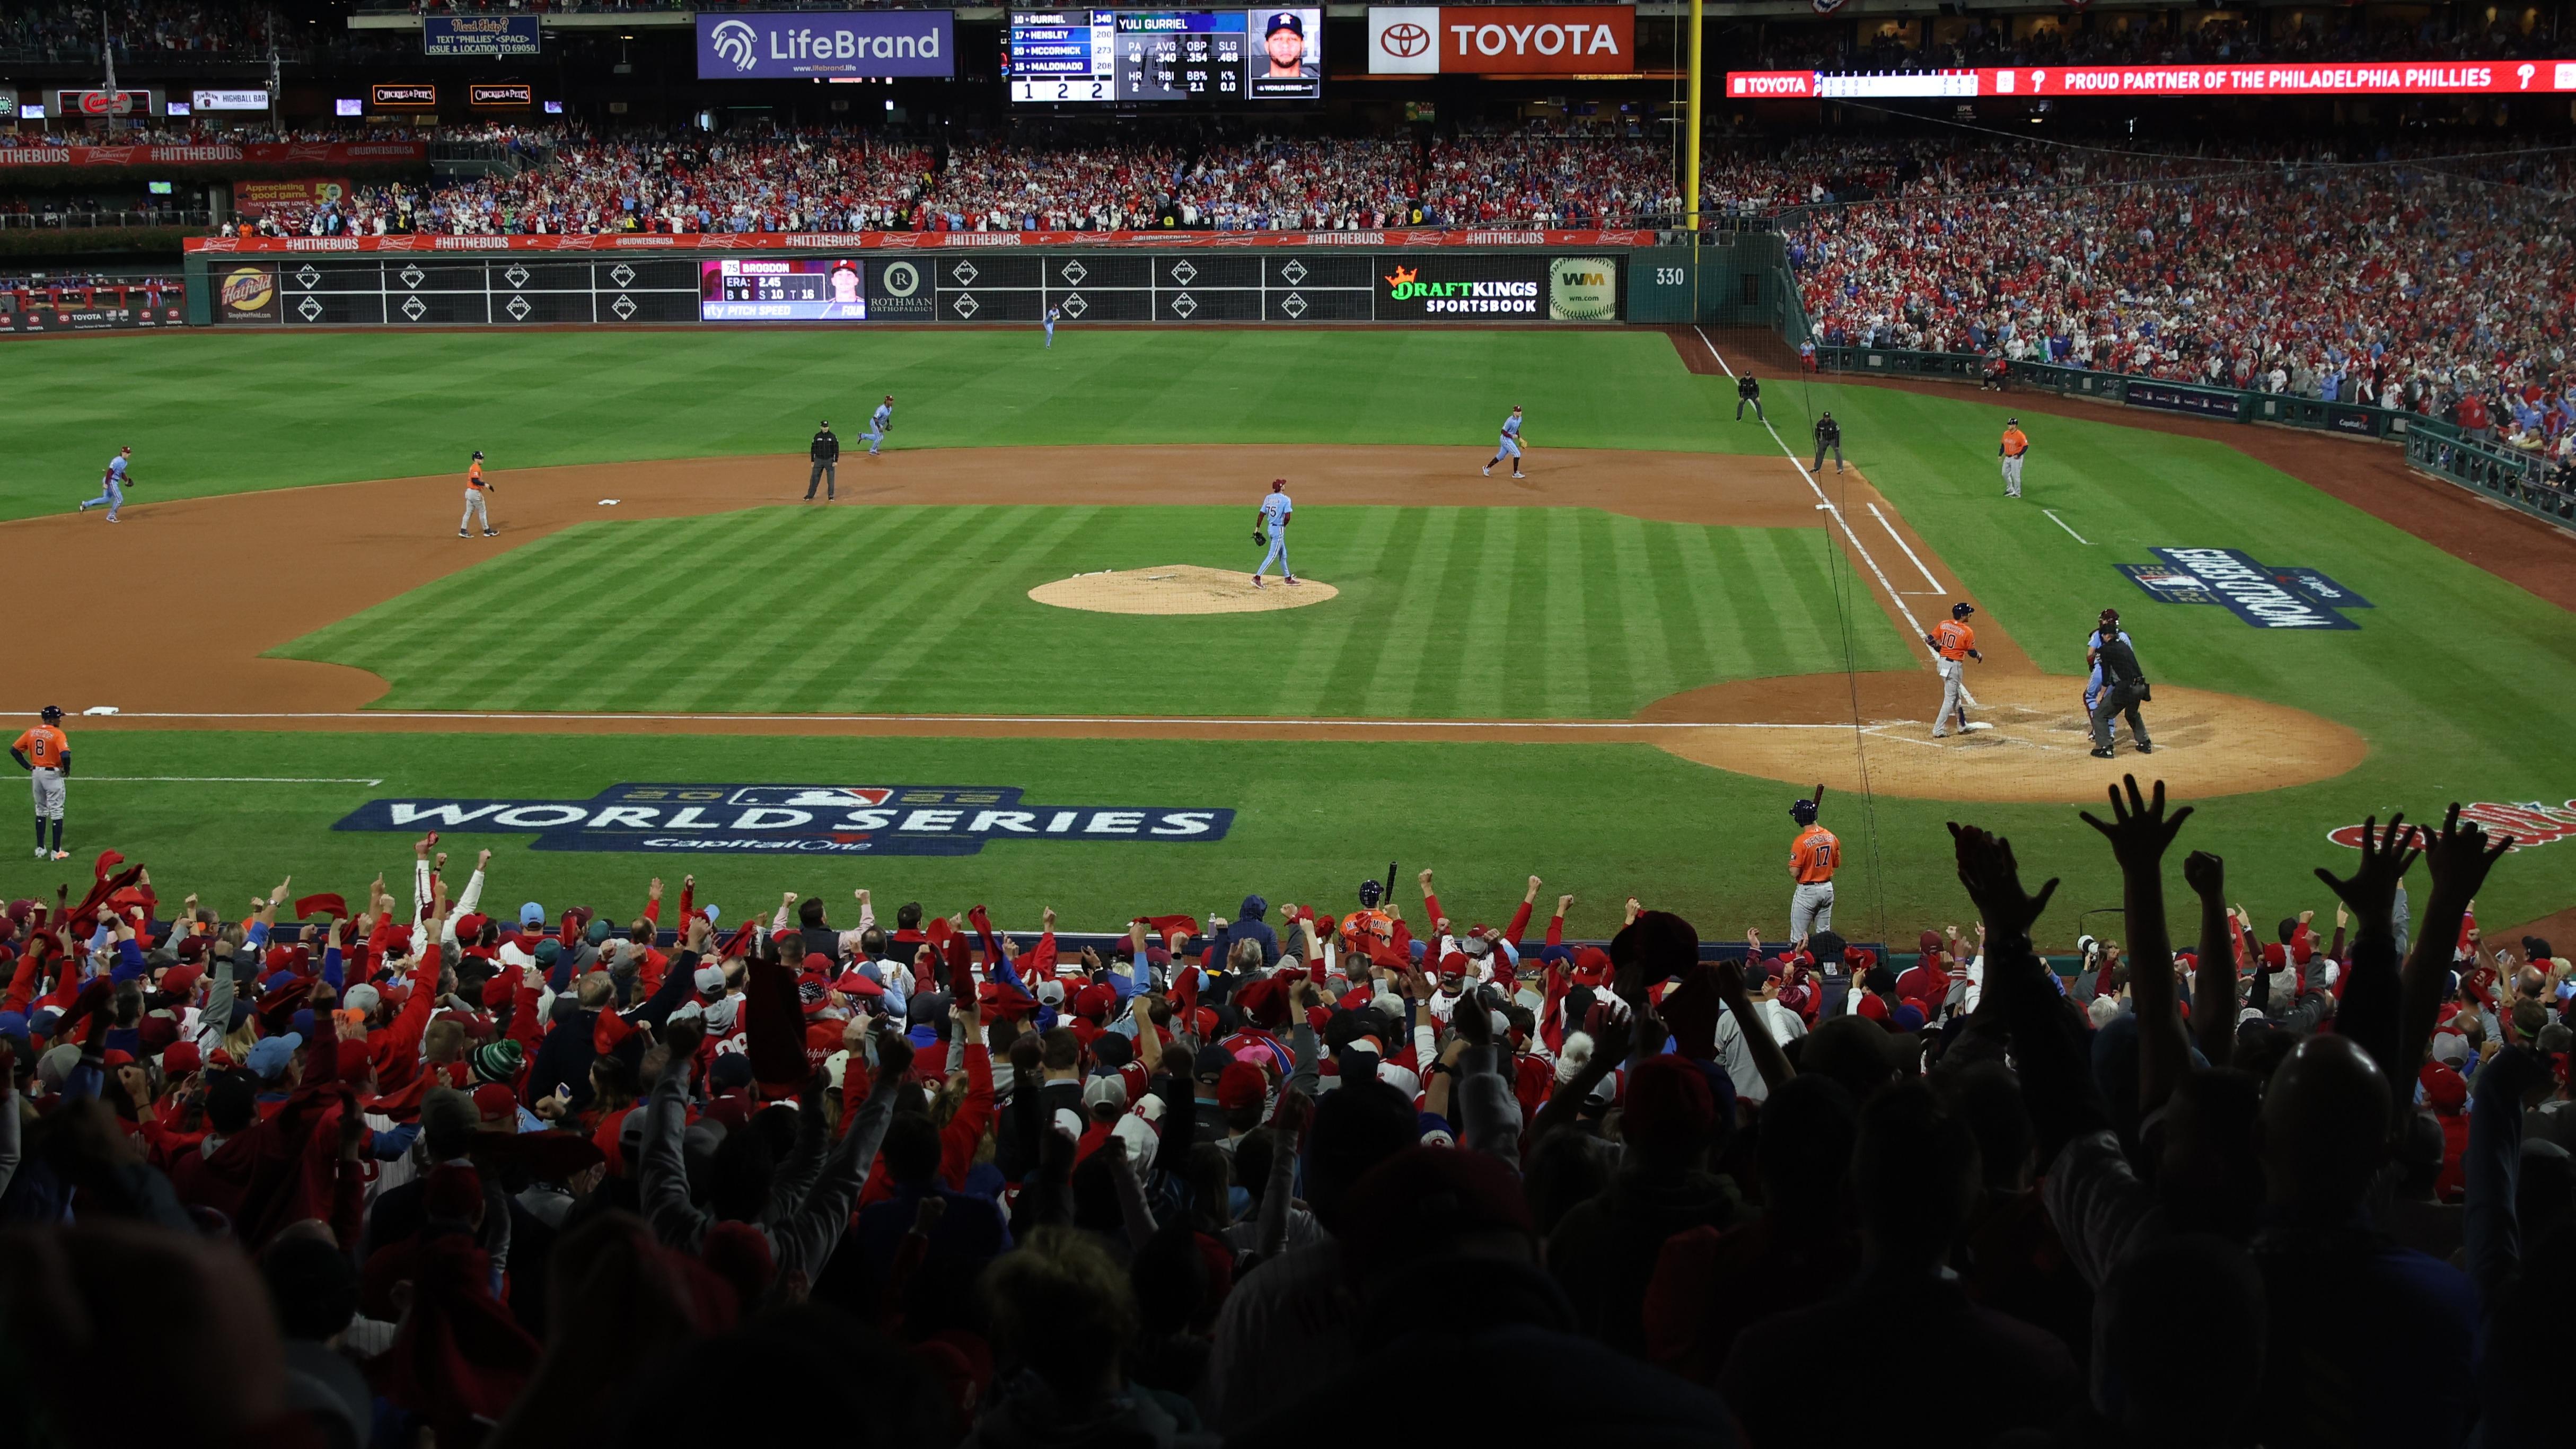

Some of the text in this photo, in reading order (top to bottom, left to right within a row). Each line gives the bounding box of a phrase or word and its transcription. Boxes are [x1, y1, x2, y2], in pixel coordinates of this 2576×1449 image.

[1014, 15, 1024, 24] 10
[1119, 20, 1188, 29] YULI GURRIEL
[451, 17, 509, 34] Need Help?
[496, 35, 530, 43] <SPACE>
[1031, 31, 1068, 39] HENSLEY
[1450, 24, 1619, 55] TOYOTA
[771, 28, 939, 59] LifeBrand
[1128, 41, 1237, 51] PA AVG OBP SLG
[1031, 47, 1081, 55] MCCORMICK
[1129, 53, 1238, 63] 48 .340 .354 .468
[1015, 63, 1024, 71] 15
[1031, 62, 1083, 71] MALDONADO
[1128, 71, 1235, 81] HR RBI BB% K%
[2065, 67, 2491, 90] PROUD PARTNER OF THE PHILADELPHIA PHILLIES
[1132, 82, 1236, 92] 2 4 2.1 0.0
[1748, 77, 1806, 93] TOYOTA
[1024, 83, 1103, 99] 1 2 2
[223, 94, 266, 103] HIGHBALL BAR
[151, 147, 243, 161] #HITTHEBUDS
[347, 146, 415, 156] @BUDWEISERUSA
[245, 183, 304, 192] Appreciating
[251, 191, 277, 200] good
[382, 239, 413, 248] Budweiser
[435, 236, 508, 248] #HITTHEBUDS
[616, 236, 674, 245] @BUDWEISERUSA
[703, 237, 734, 245] Budweiser
[785, 235, 861, 247] #HITTHEBUDS
[885, 235, 916, 244] Budweiser
[944, 234, 1021, 245] #HITTHEBUDS
[1306, 232, 1384, 245] #HITTHEBUDS
[286, 239, 359, 250] #HITTHEBUDS
[726, 264, 789, 274] 75 BROGDON
[727, 277, 781, 287] ERA: 2.45
[895, 273, 908, 285] R
[1562, 273, 1605, 286] WM
[1656, 268, 1684, 285] 330
[222, 274, 272, 305] Hatfield
[727, 291, 734, 300] B
[741, 290, 749, 300] 6
[759, 291, 766, 300] S
[771, 289, 784, 300] 10
[802, 289, 814, 300] 16
[1392, 281, 1537, 300] DRAFTKINGS
[871, 297, 933, 306] ROTHMAN
[1427, 300, 1536, 312] SPORTSBOOK
[728, 305, 865, 316] PITCH SPEED FOUR
[1266, 506, 1278, 518] 75
[2162, 548, 2264, 581] SERIES
[2214, 581, 2333, 627] WORLD
[1942, 631, 1956, 649] 10
[35, 739, 45, 757] 8
[390, 803, 1215, 836] WORLD SERIES
[1815, 845, 1831, 867] 17
